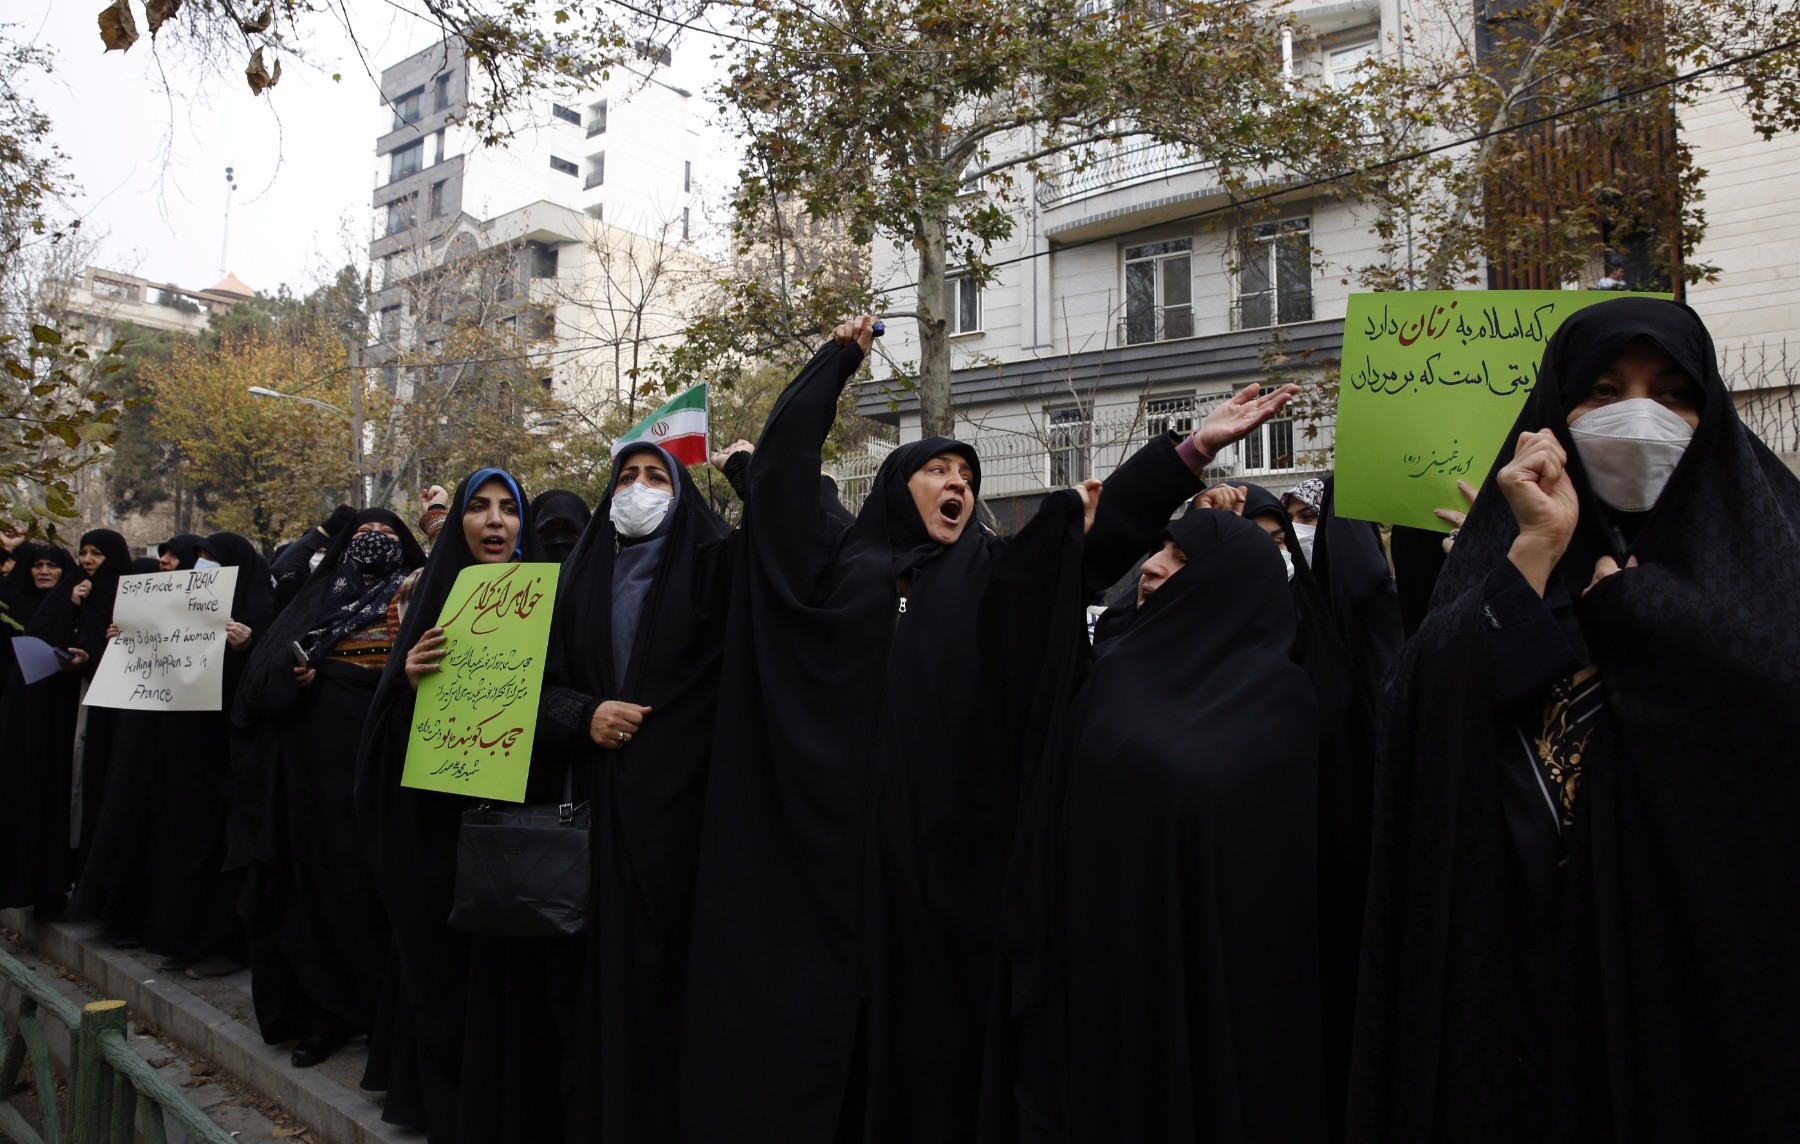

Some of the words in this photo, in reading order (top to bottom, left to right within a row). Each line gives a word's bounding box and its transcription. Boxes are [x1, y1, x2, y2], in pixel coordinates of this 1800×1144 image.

[1364, 304, 1398, 341] دارد
[1398, 300, 1459, 347] زنان
[1456, 315, 1474, 346] به
[1469, 306, 1523, 340] اسلام
[1525, 303, 1554, 342] که
[1350, 355, 1397, 393] مردان
[1419, 352, 1441, 386] که
[1439, 359, 1489, 388] است
[1408, 439, 1459, 478] خمینی
[185, 570, 219, 594] IRAN
[441, 564, 520, 628] گرامی
[188, 598, 219, 612] France
[471, 577, 544, 634] خواهران
[114, 631, 135, 654] Every
[137, 631, 144, 643] 3
[146, 632, 162, 652] days
[171, 629, 180, 643] A
[184, 631, 216, 642] woman
[508, 657, 533, 672] حجاب
[129, 684, 174, 702] France
[480, 727, 524, 757] حجاب
[454, 759, 480, 781] شهید
